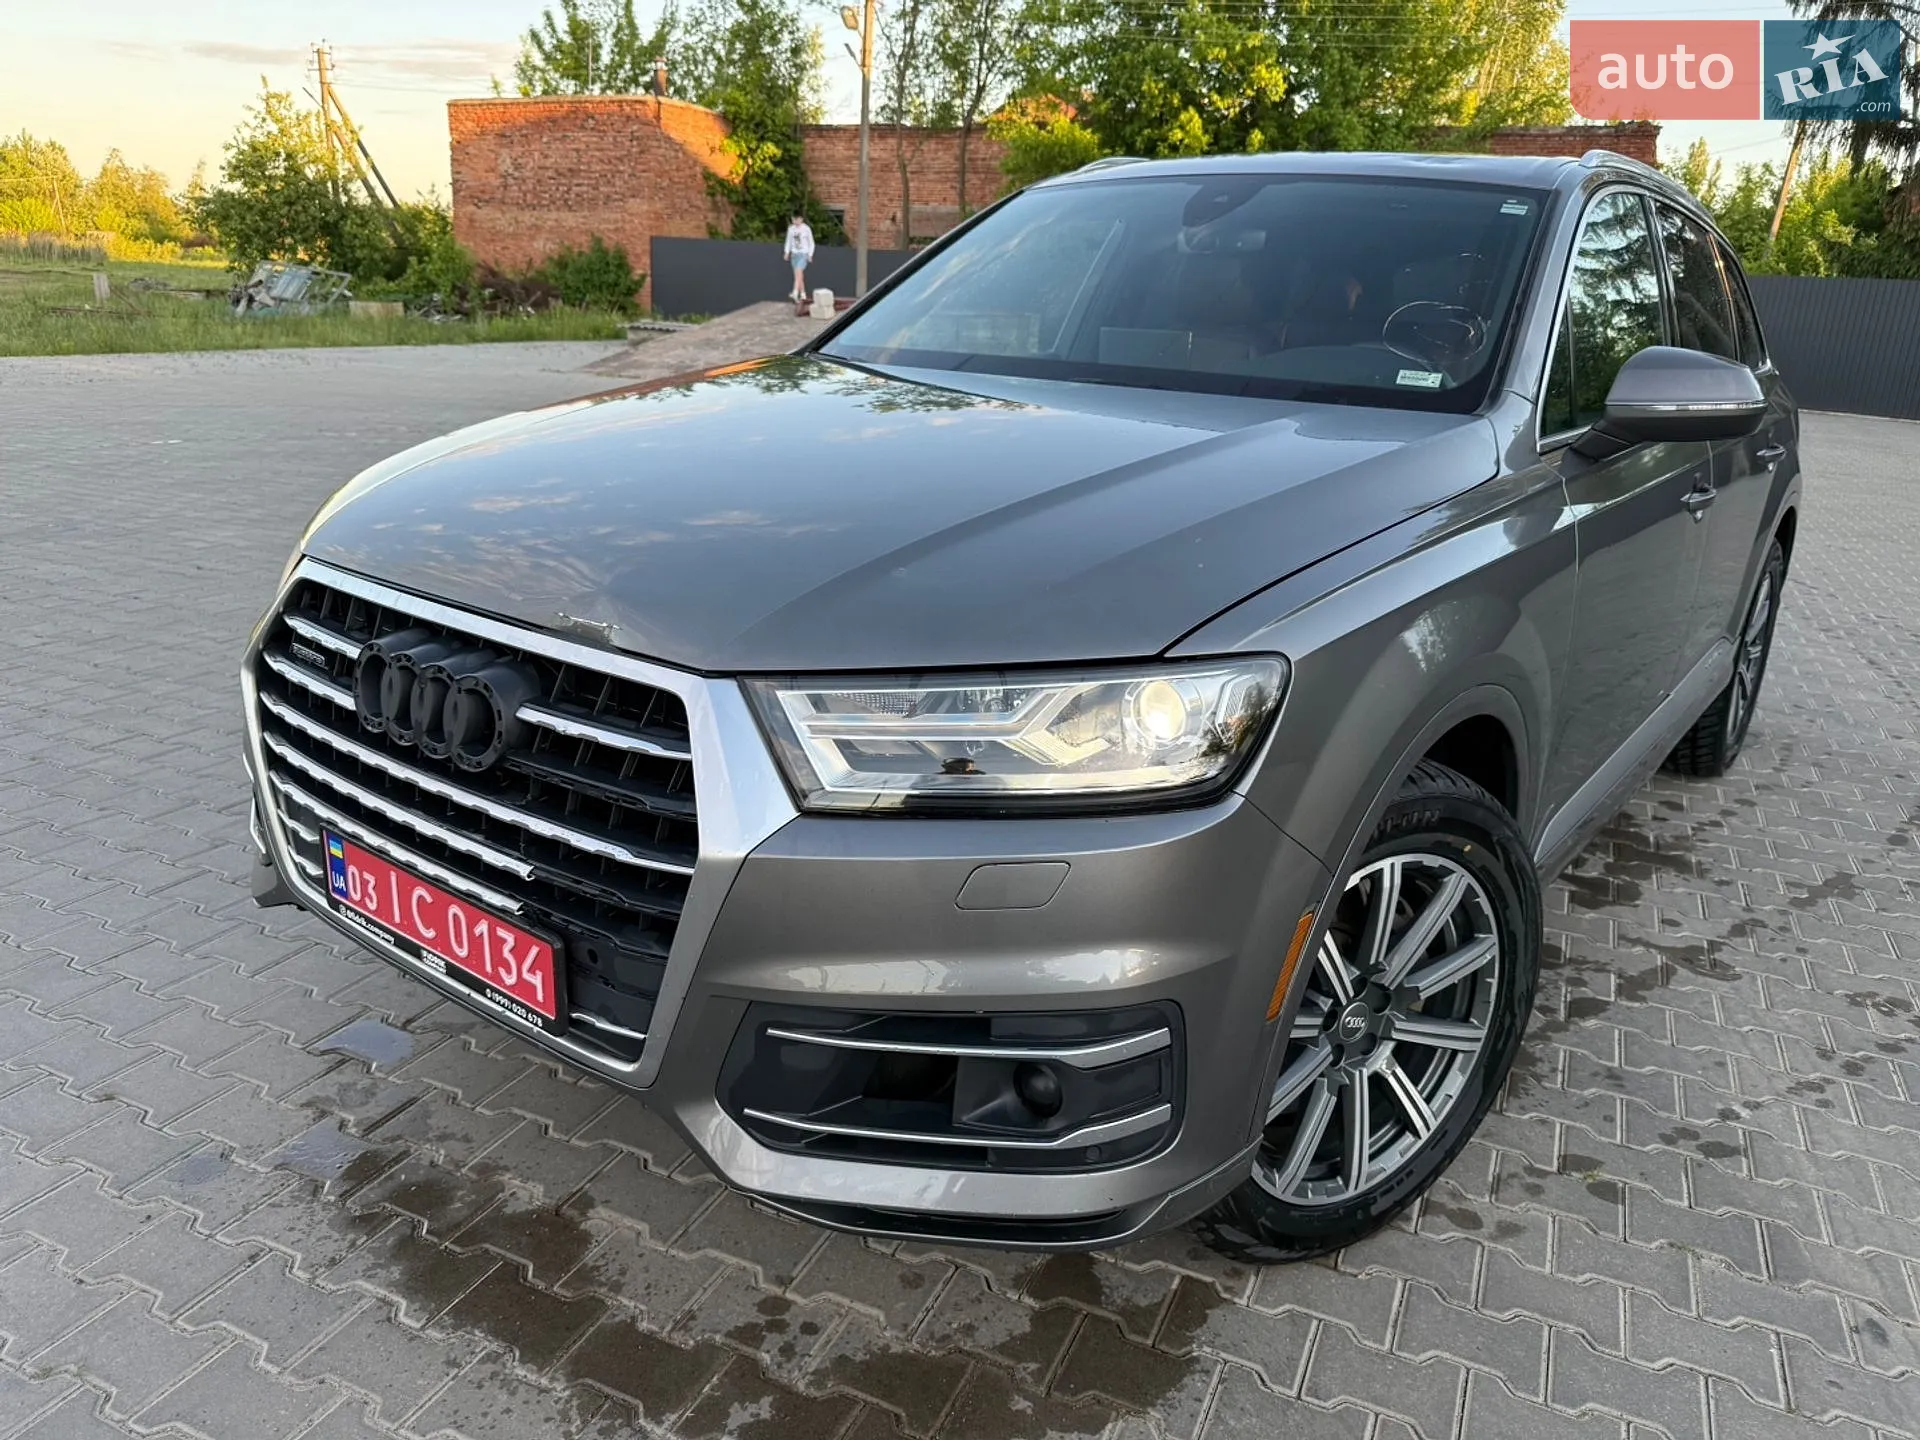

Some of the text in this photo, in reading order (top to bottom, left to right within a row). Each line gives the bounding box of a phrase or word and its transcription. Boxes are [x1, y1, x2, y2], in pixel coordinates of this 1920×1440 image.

[332, 871, 346, 892] UA
[348, 865, 377, 910] 03
[448, 904, 544, 1003] 0134
